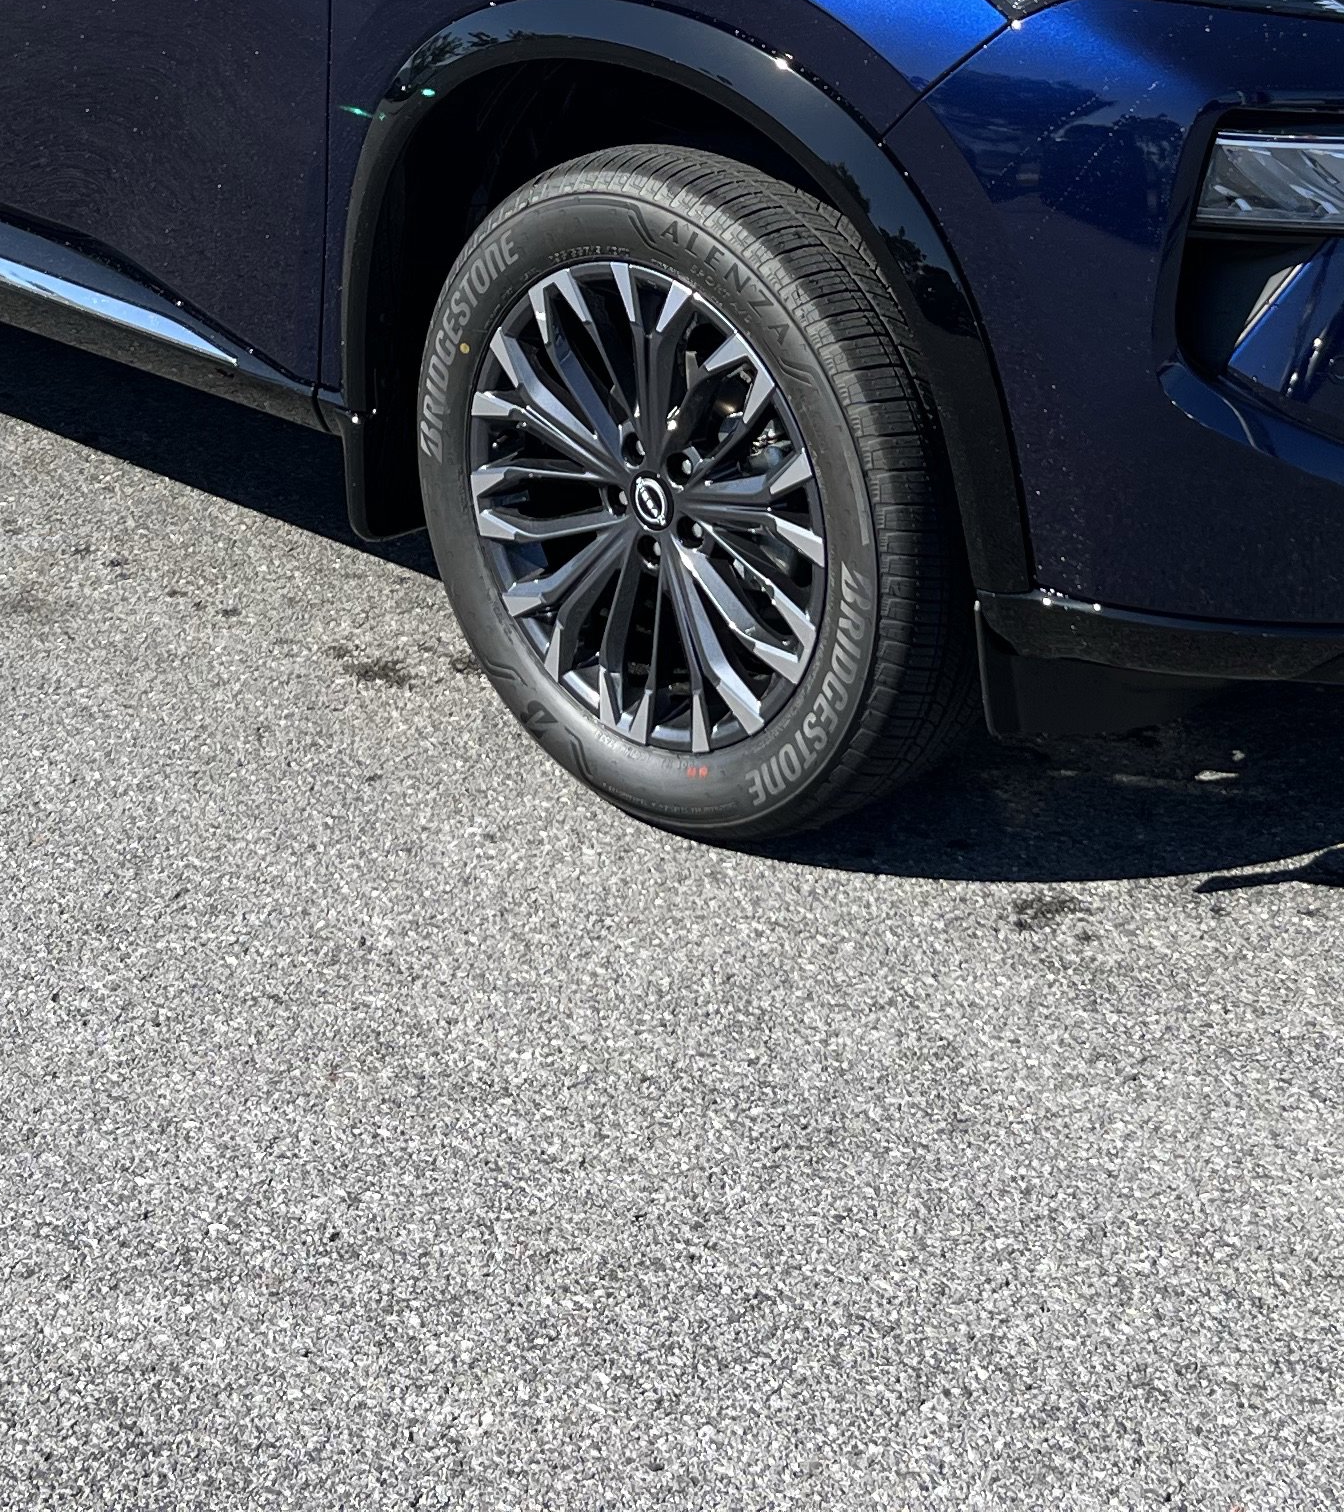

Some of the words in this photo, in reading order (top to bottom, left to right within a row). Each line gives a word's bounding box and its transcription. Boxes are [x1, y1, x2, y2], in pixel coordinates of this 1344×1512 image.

[420, 228, 519, 465] BRIDGESTONE
[659, 219, 790, 345] ALENZA
[744, 560, 873, 807] BRIDGESTONE
